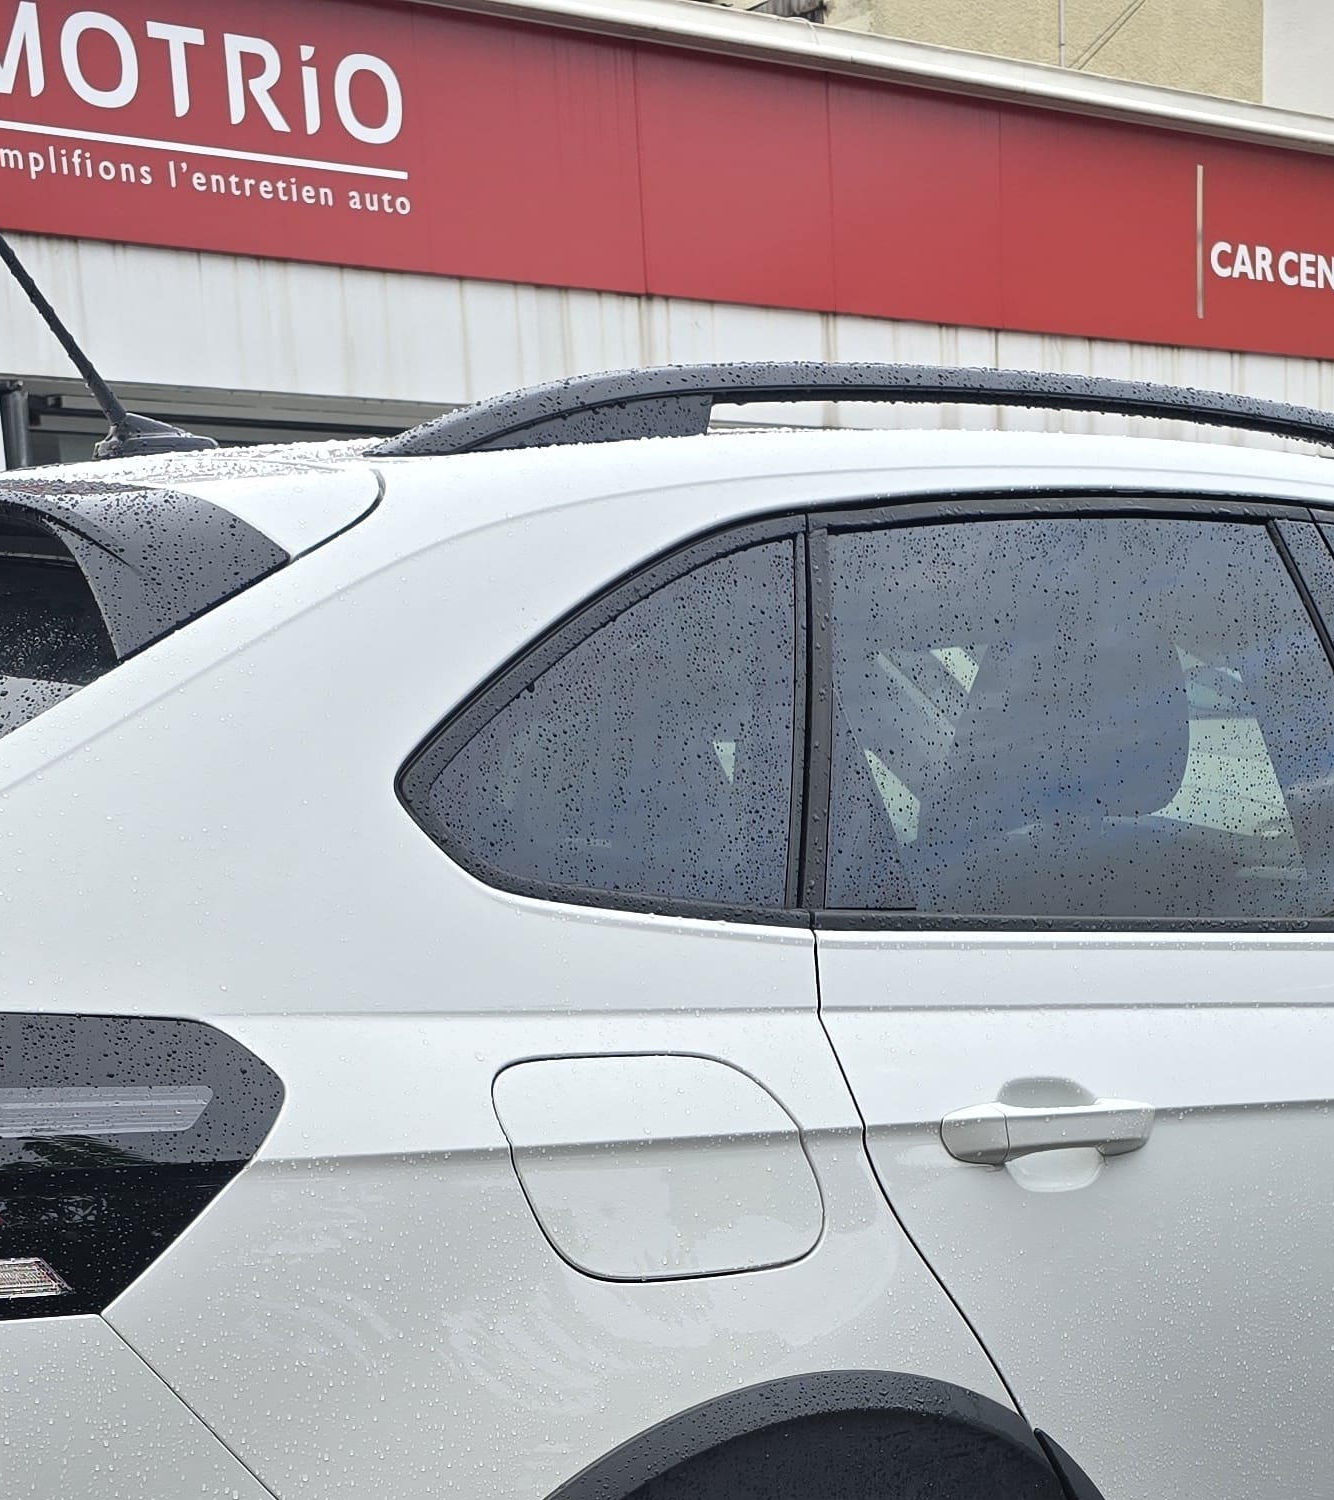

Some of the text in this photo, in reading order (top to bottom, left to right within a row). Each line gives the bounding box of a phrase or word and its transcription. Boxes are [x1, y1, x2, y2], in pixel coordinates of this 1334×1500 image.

[168, 160, 334, 208] l'entretien
[348, 190, 411, 215] auto
[1210, 241, 1275, 283] CAR
